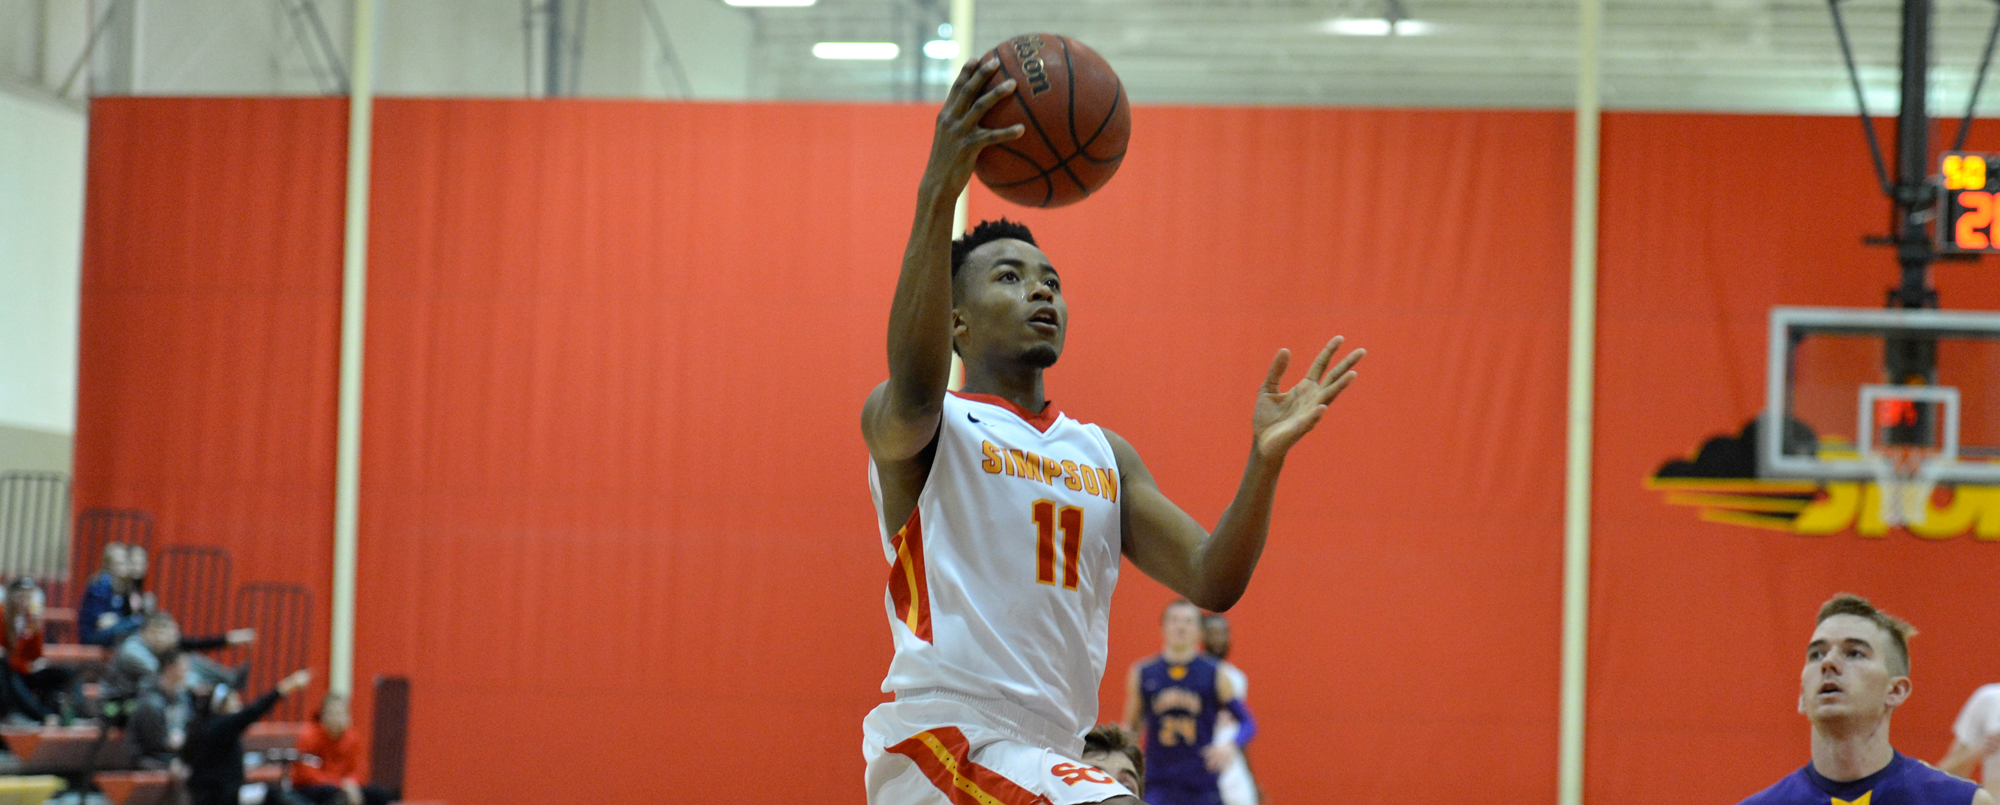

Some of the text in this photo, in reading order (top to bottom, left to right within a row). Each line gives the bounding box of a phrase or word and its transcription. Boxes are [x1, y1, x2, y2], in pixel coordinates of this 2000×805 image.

[982, 440, 1118, 503] SIMPSON
[1032, 498, 1084, 591] 11
[1051, 762, 1115, 786] SC
